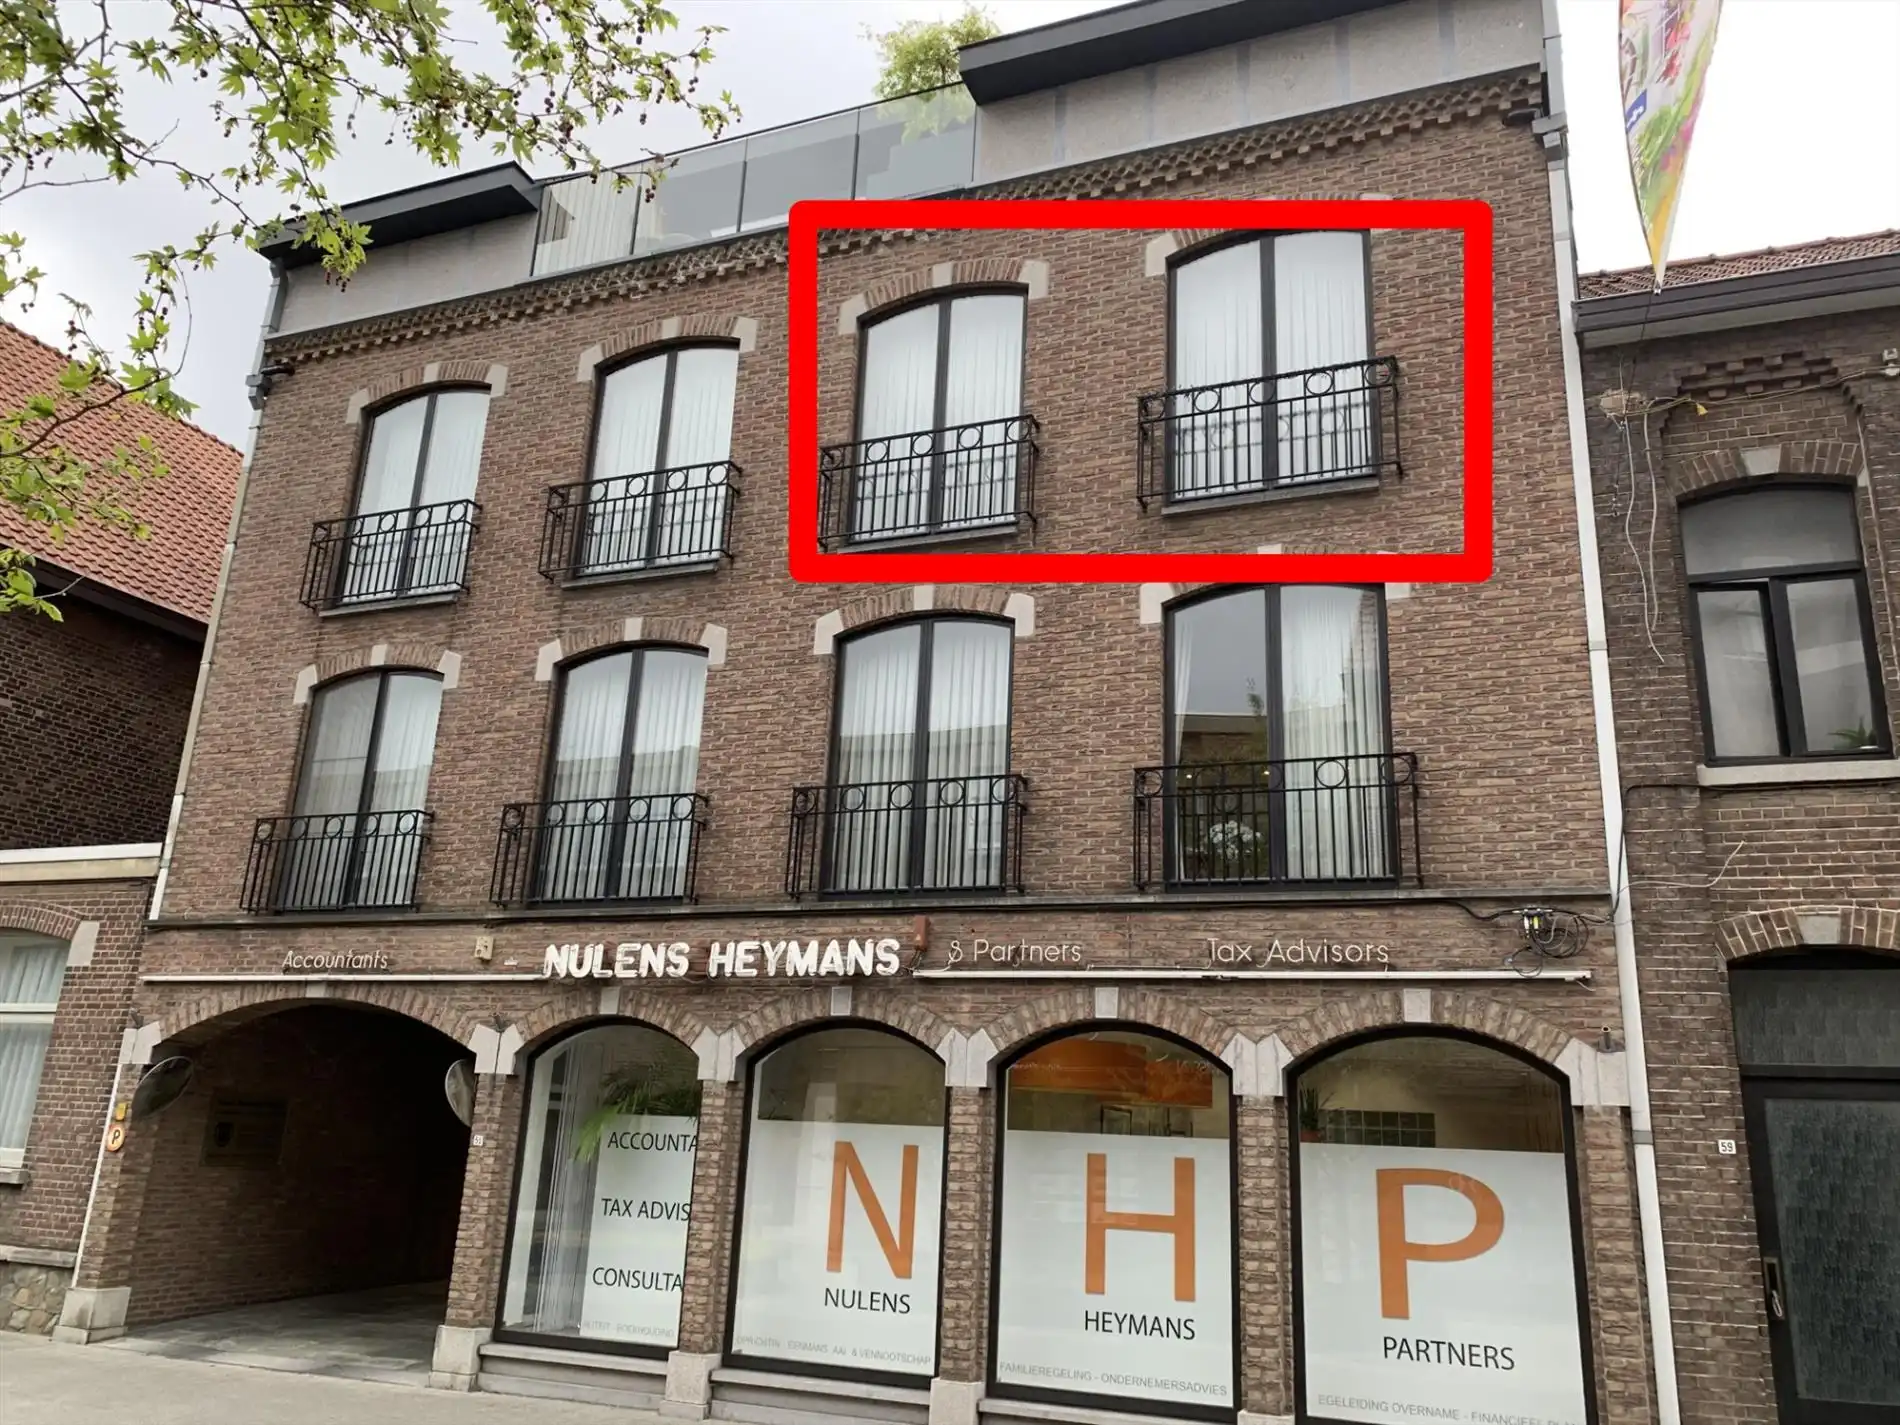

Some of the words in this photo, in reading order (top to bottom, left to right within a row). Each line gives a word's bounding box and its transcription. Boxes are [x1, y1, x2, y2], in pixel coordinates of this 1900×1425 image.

[282, 949, 388, 969] Accountants
[543, 942, 690, 978] NULENS
[708, 938, 900, 977] HEYMANS
[974, 938, 1081, 962] Partners
[1207, 937, 1252, 962] Tax
[1261, 938, 1389, 964] Advisors
[607, 1132, 697, 1152] ACCOUNTA
[1720, 1141, 1733, 1152] 59
[602, 1198, 633, 1217] TAX
[637, 1201, 690, 1221] ADVIS
[826, 1140, 918, 1279] N
[1085, 1153, 1196, 1303] H
[1376, 1167, 1505, 1320] P
[592, 1267, 683, 1292] CONSULTA
[824, 1287, 910, 1314] NULENS
[1084, 1310, 1196, 1341] HEYMANS
[1383, 1336, 1515, 1371] PARTNERS
[999, 1361, 1092, 1381] FAMILIEREGELING
[1101, 1372, 1228, 1397] ONDERNEMERSADVIES
[1392, 1402, 1460, 1420] OVERNAME
